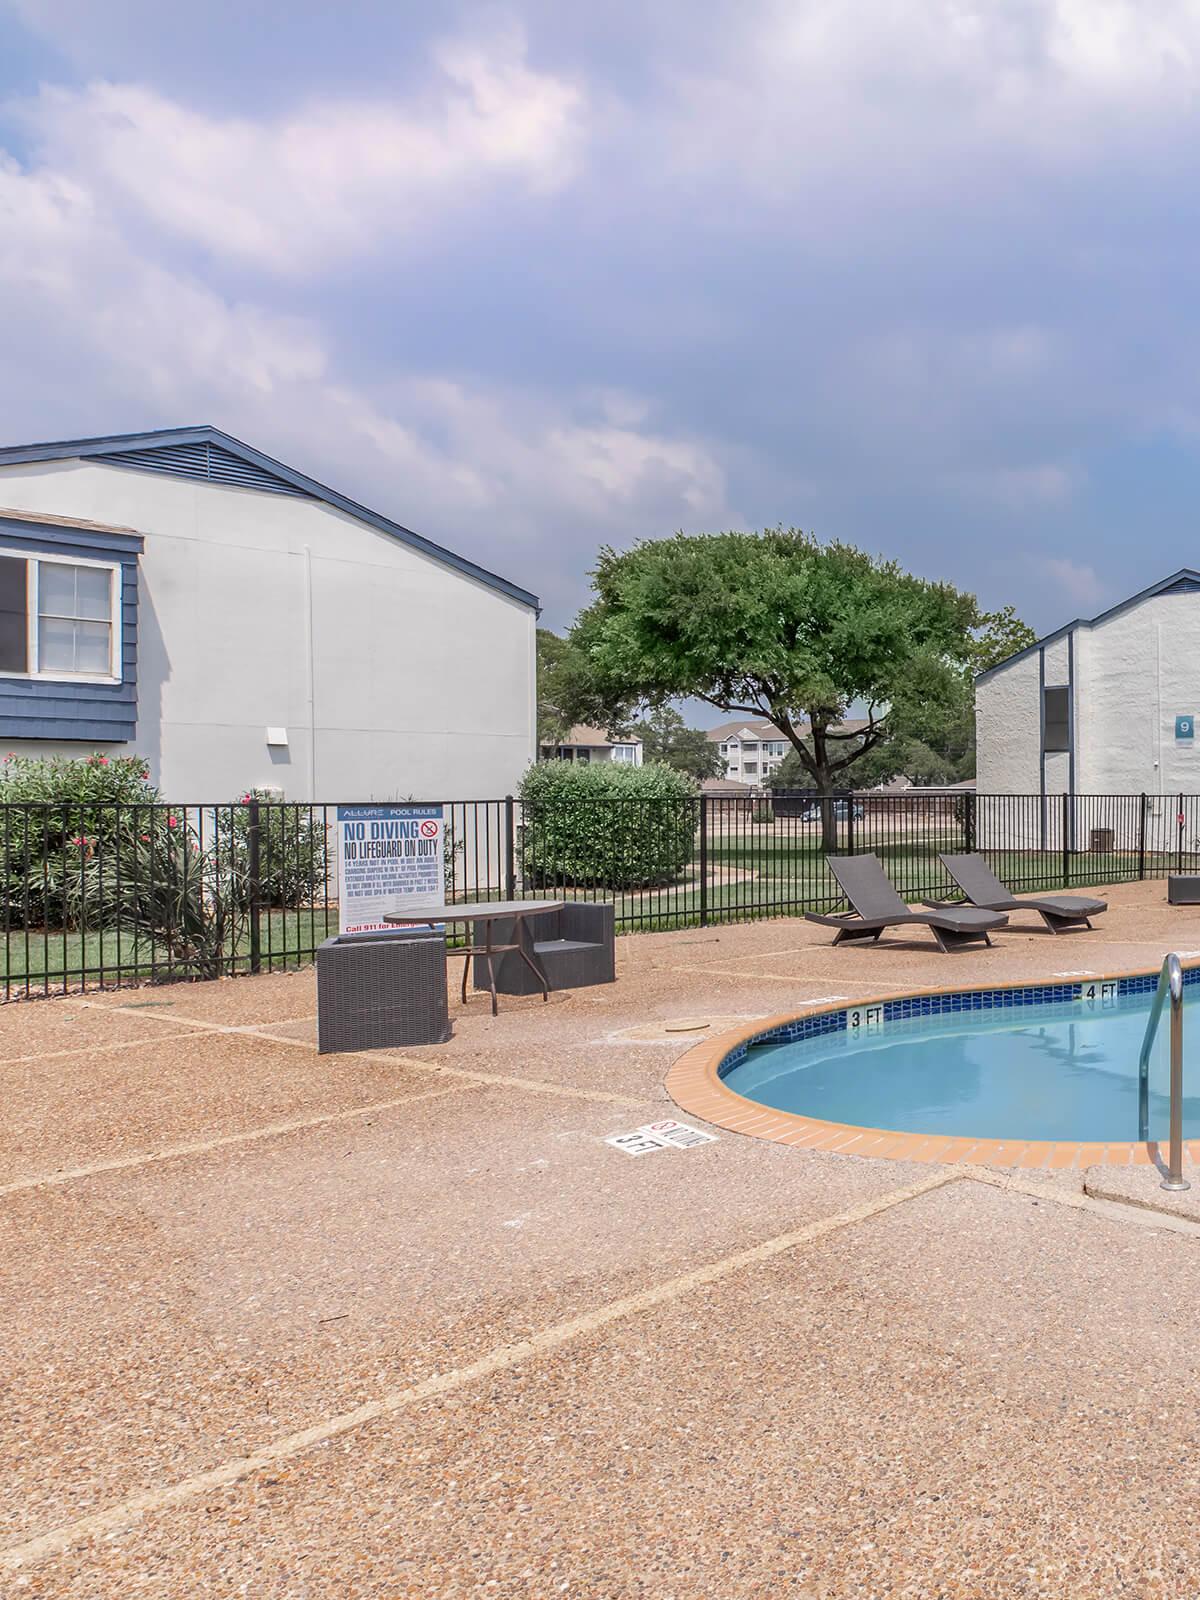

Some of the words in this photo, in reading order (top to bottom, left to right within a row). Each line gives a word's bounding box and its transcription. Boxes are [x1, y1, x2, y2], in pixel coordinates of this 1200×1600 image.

[1181, 721, 1189, 732] 9
[344, 822, 365, 840] NO
[371, 820, 419, 839] DIVING
[345, 842, 357, 860] NO
[360, 840, 402, 859] LIFEGUARD
[405, 840, 416, 857] ON
[418, 838, 438, 857] DUTY
[1087, 985, 1096, 999] 4
[1102, 984, 1115, 998] FT
[852, 1011, 860, 1027] 3
[866, 1007, 881, 1025] FT
[616, 1135, 643, 1144] 3
[626, 1140, 663, 1153] FT
